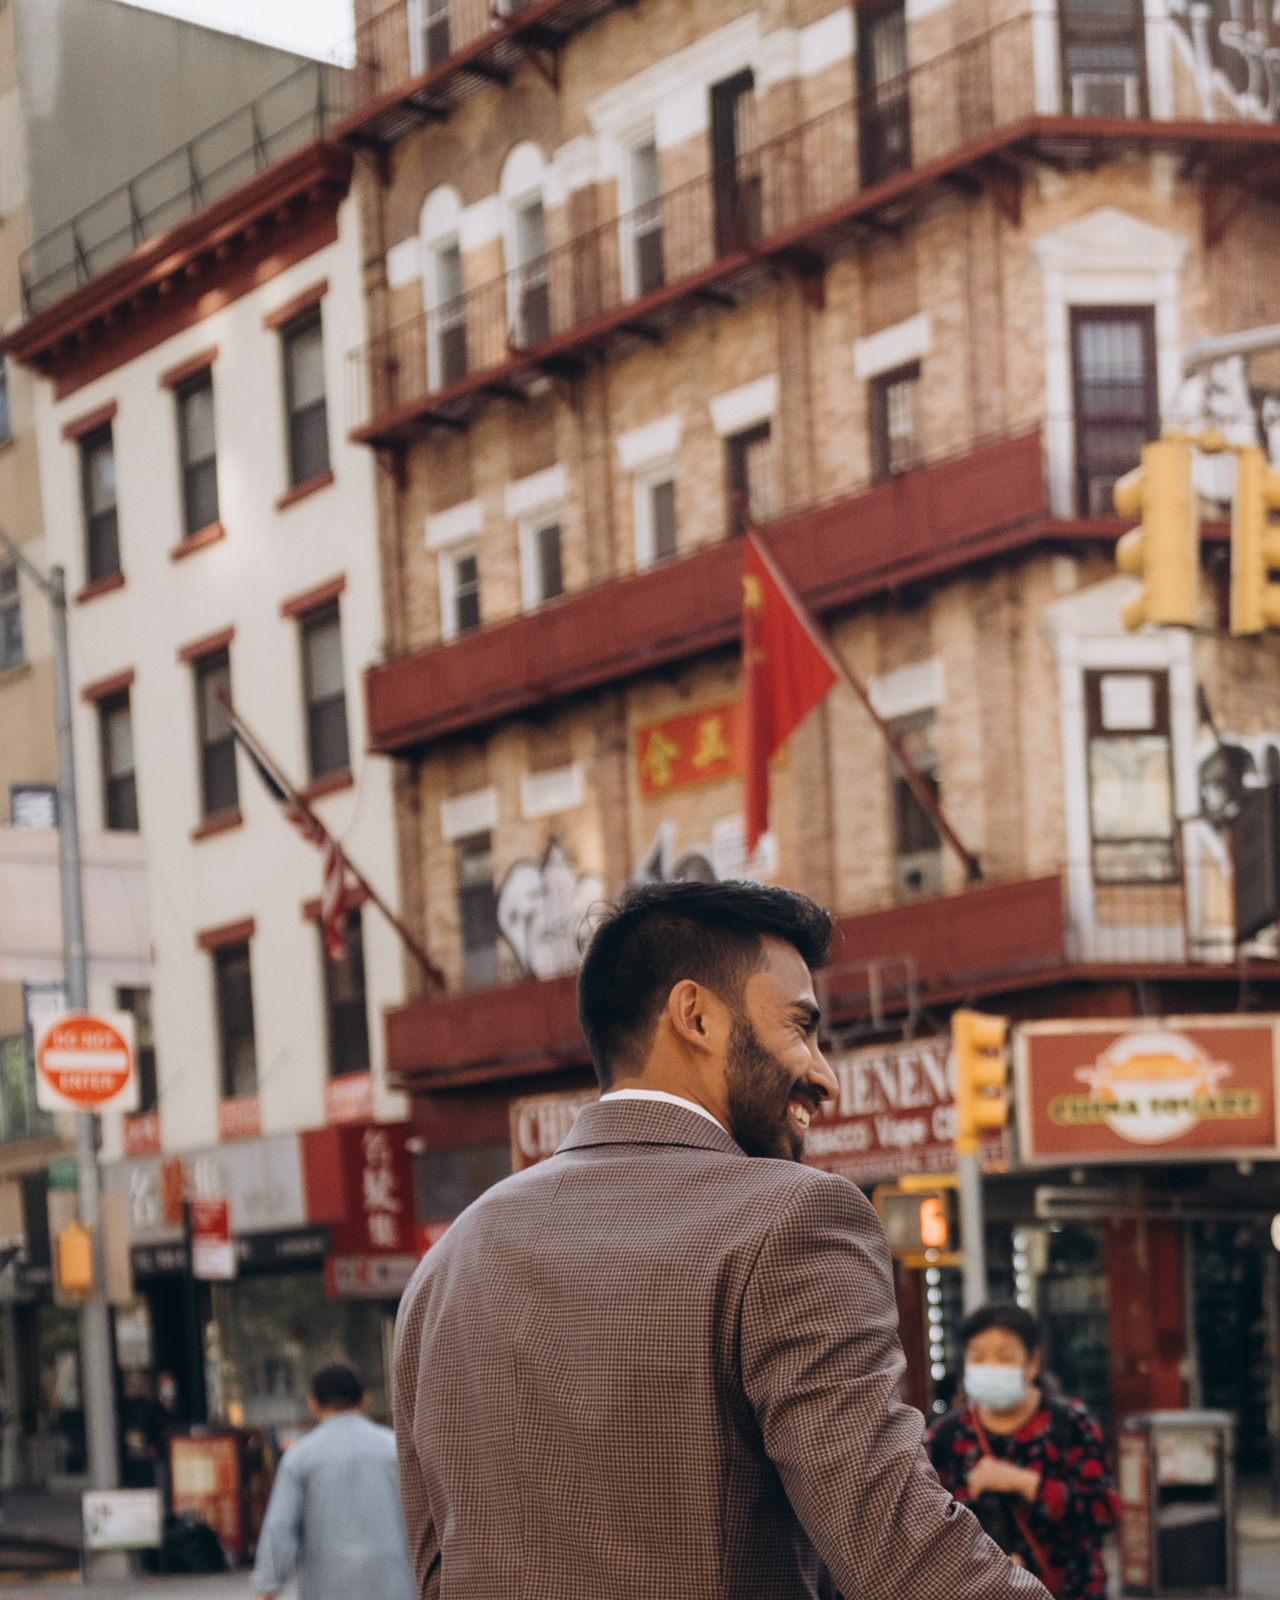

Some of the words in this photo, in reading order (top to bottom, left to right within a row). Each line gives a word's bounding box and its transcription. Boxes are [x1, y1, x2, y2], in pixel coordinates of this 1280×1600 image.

[53, 1029, 77, 1050] DO
[81, 1028, 117, 1050] NOT
[59, 1072, 115, 1092] ENTER
[919, 1198, 948, 1247] 6
